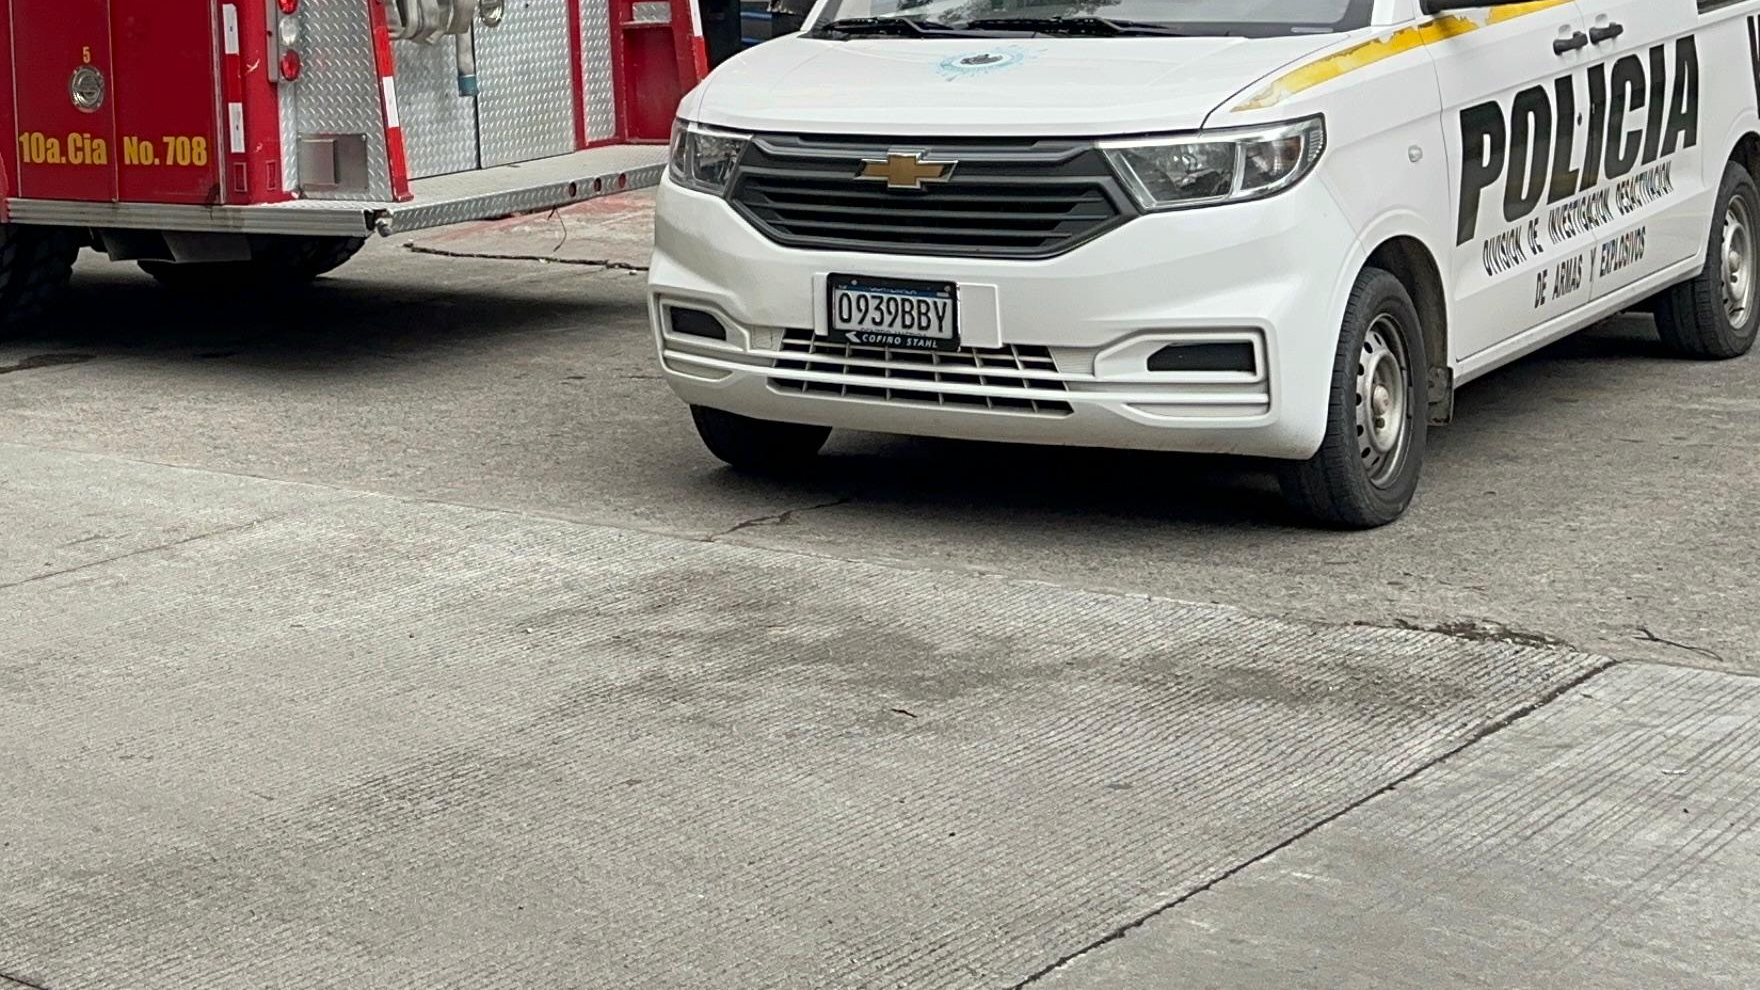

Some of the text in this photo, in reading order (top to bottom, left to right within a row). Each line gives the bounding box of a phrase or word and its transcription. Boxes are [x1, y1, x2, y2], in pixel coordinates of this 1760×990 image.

[82, 46, 91, 64] 5
[123, 136, 208, 166] No. 708
[1456, 34, 1699, 247] POLICIA
[1482, 159, 1675, 277] DIVISION DE INVESTIGACION DESACTIVACION
[1534, 225, 1647, 309] DE ARMAS Y EXPLOSIVOS
[906, 337, 938, 349] STAHL
